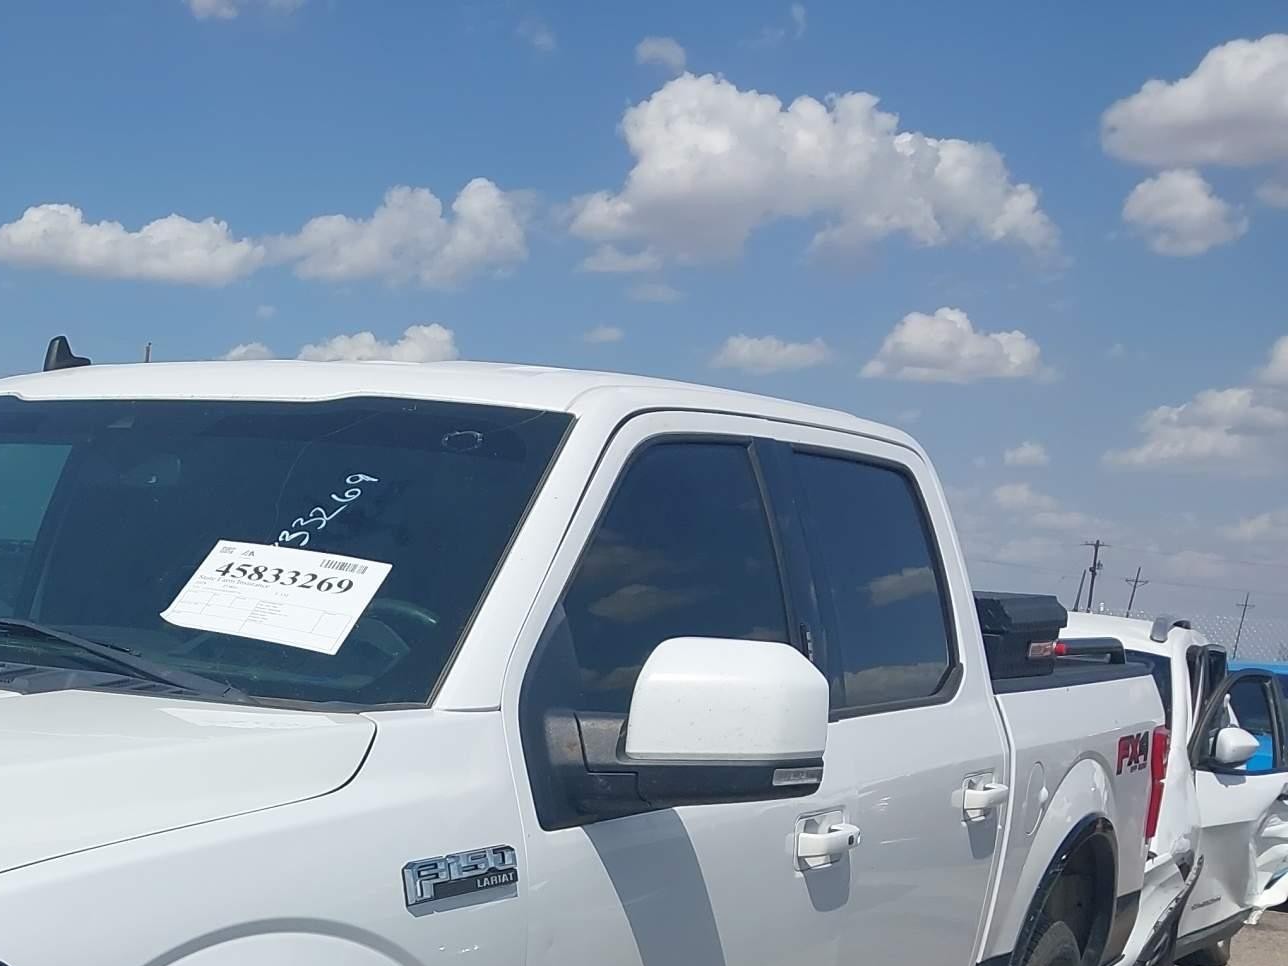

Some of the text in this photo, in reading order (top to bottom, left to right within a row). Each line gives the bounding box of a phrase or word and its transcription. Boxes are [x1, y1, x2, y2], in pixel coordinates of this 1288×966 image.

[272, 473, 379, 548] 33269
[215, 561, 354, 595] 45833269
[476, 872, 515, 889] LARIAT
